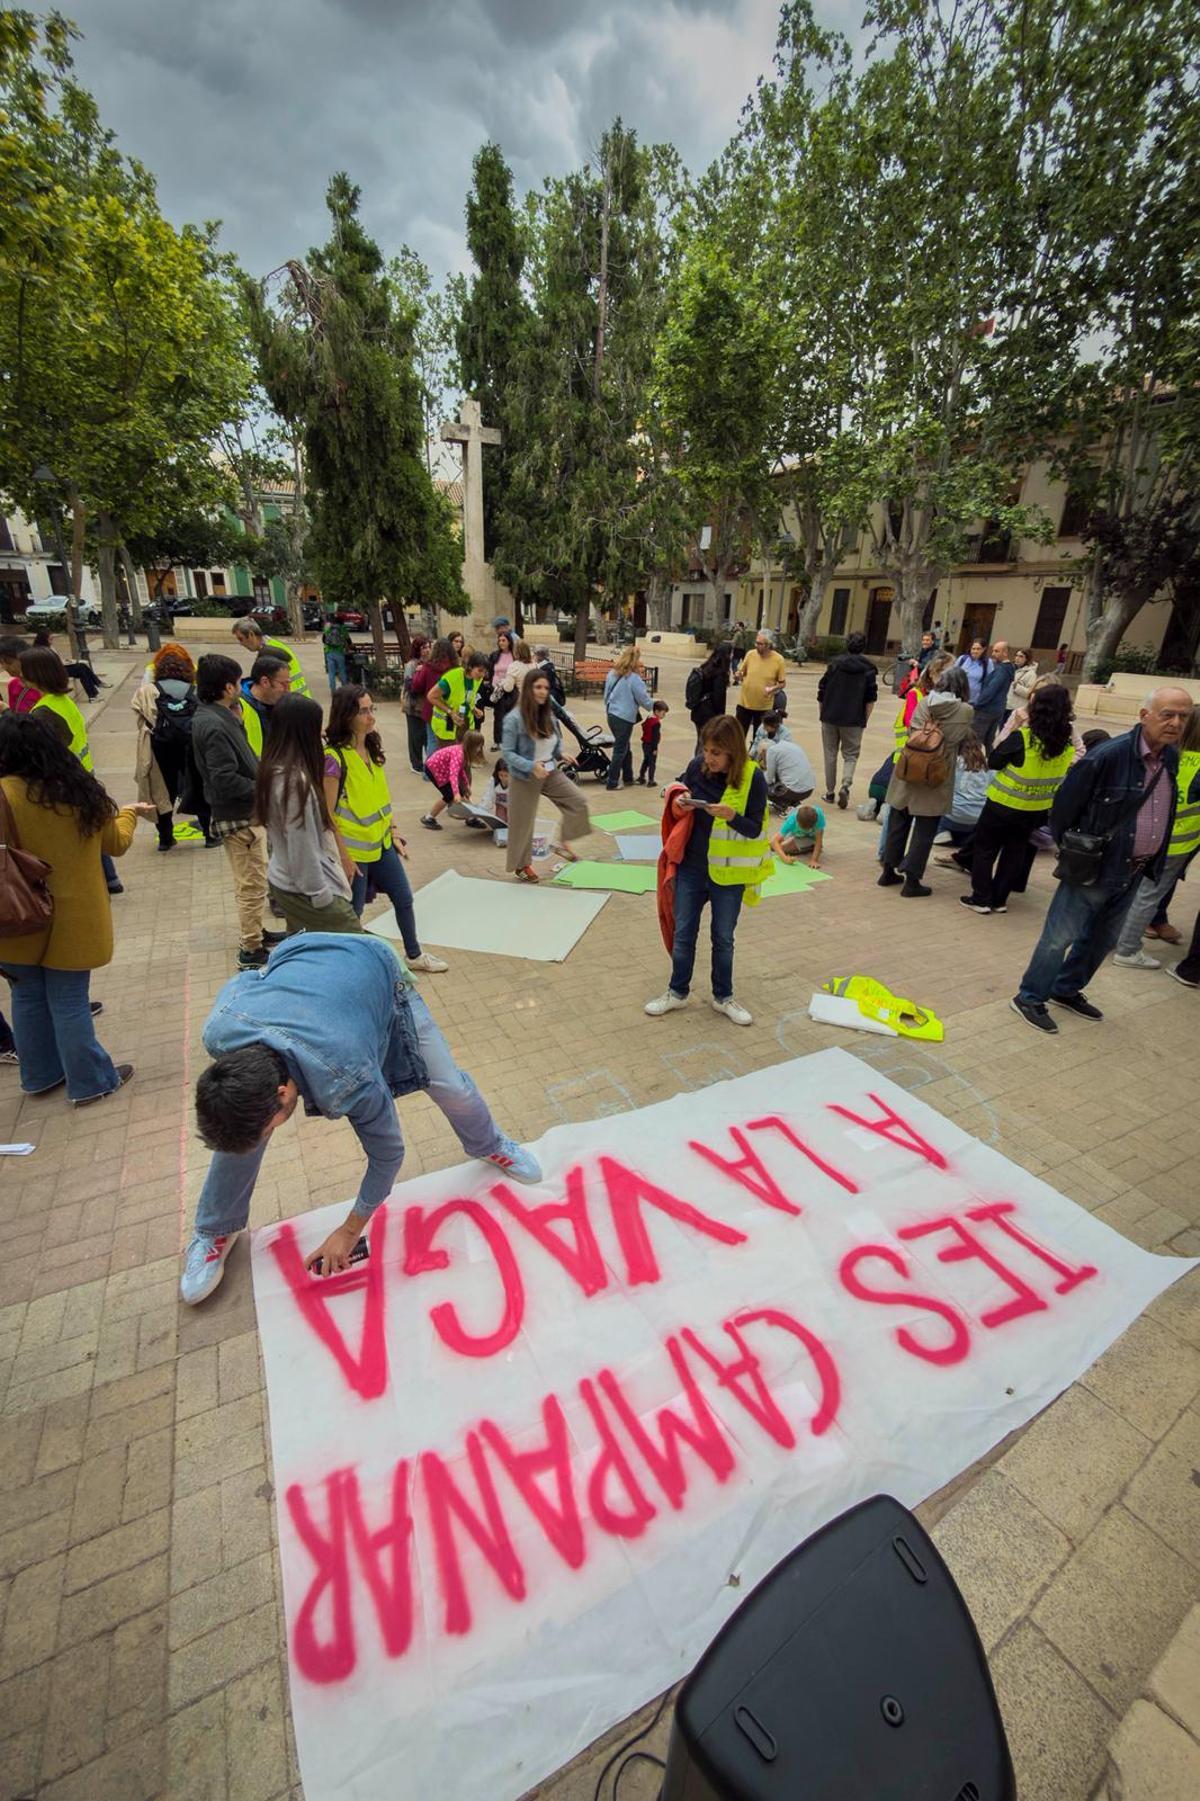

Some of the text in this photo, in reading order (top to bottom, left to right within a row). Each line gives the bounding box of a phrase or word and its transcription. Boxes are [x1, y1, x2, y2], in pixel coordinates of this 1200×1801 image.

[264, 1092, 949, 1401] A LA VAGA
[286, 1201, 1099, 1685] IES CAMPANAR
